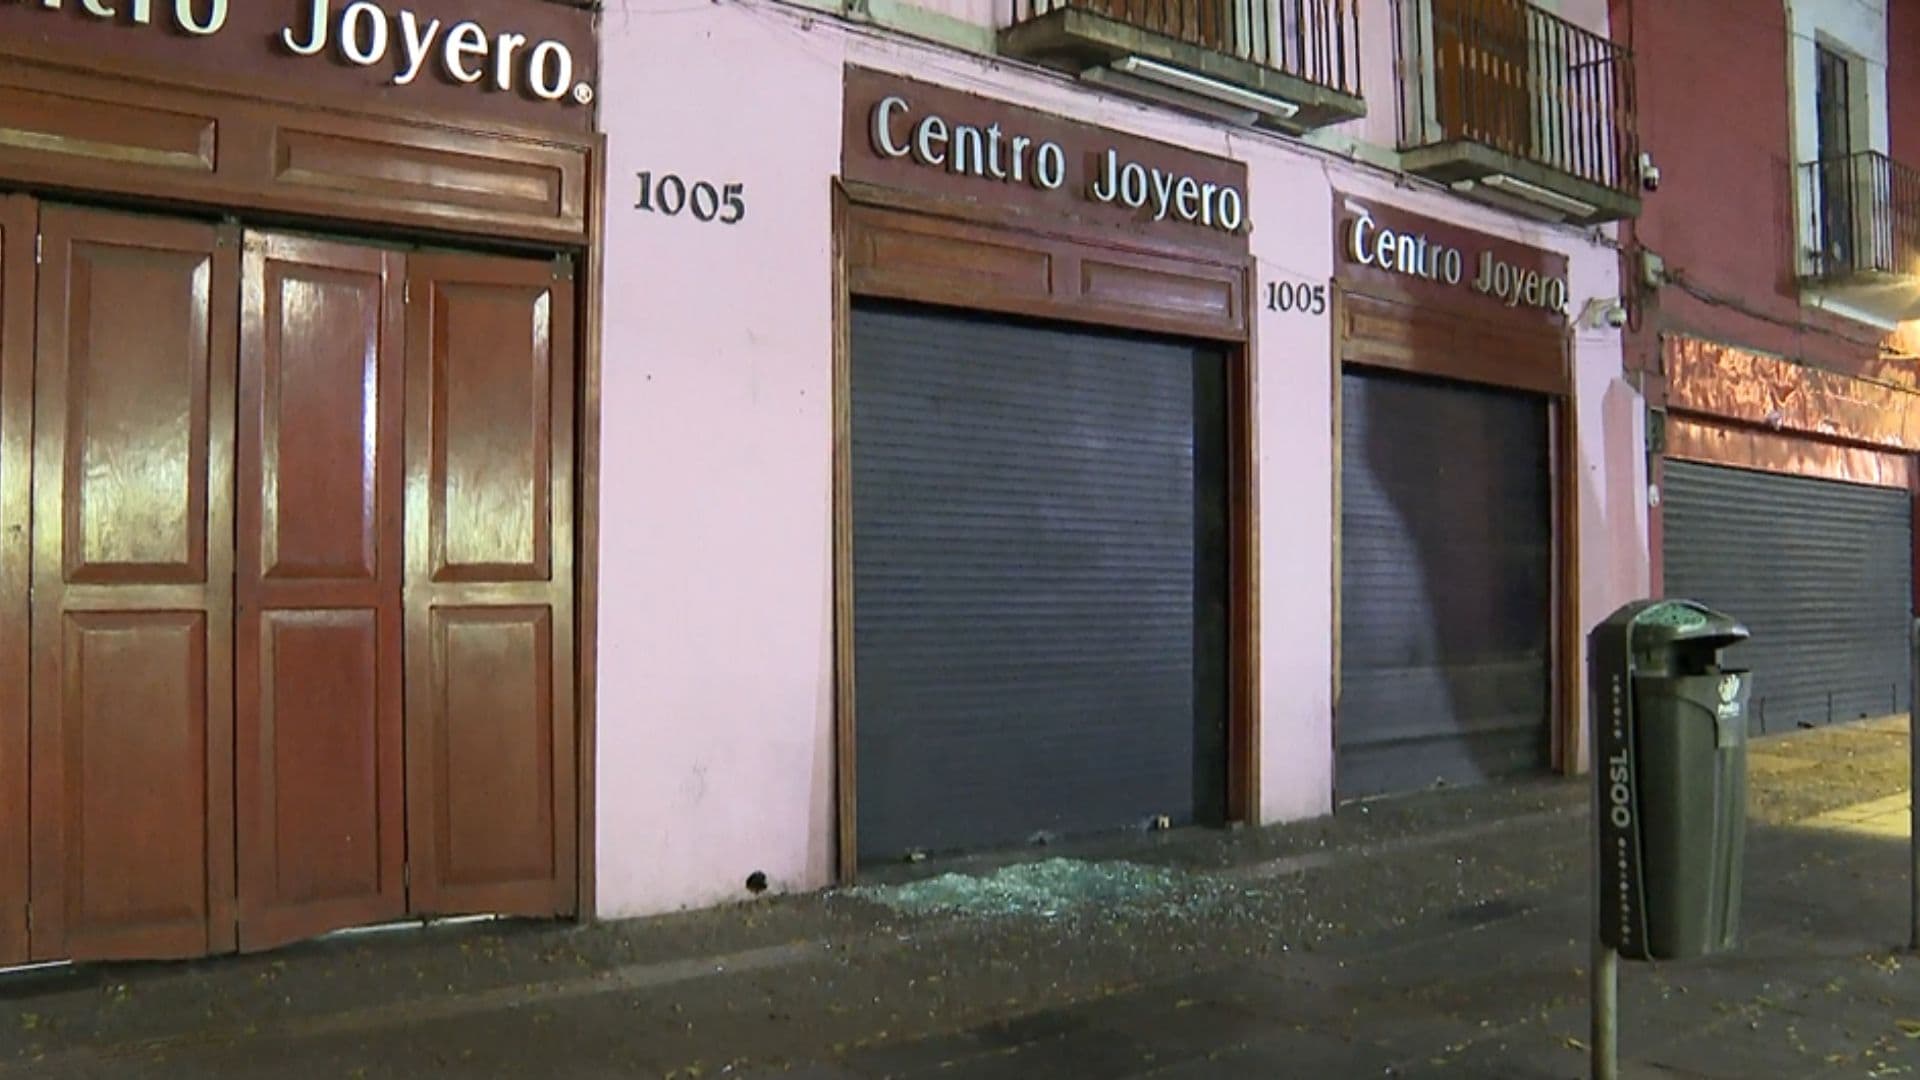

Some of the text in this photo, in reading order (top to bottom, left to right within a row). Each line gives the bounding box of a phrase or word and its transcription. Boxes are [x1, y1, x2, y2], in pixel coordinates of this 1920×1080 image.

[871, 96, 1066, 190] Centro
[634, 171, 745, 224] 1005
[1352, 213, 1463, 285] Centro
[1267, 281, 1326, 315] 1005
